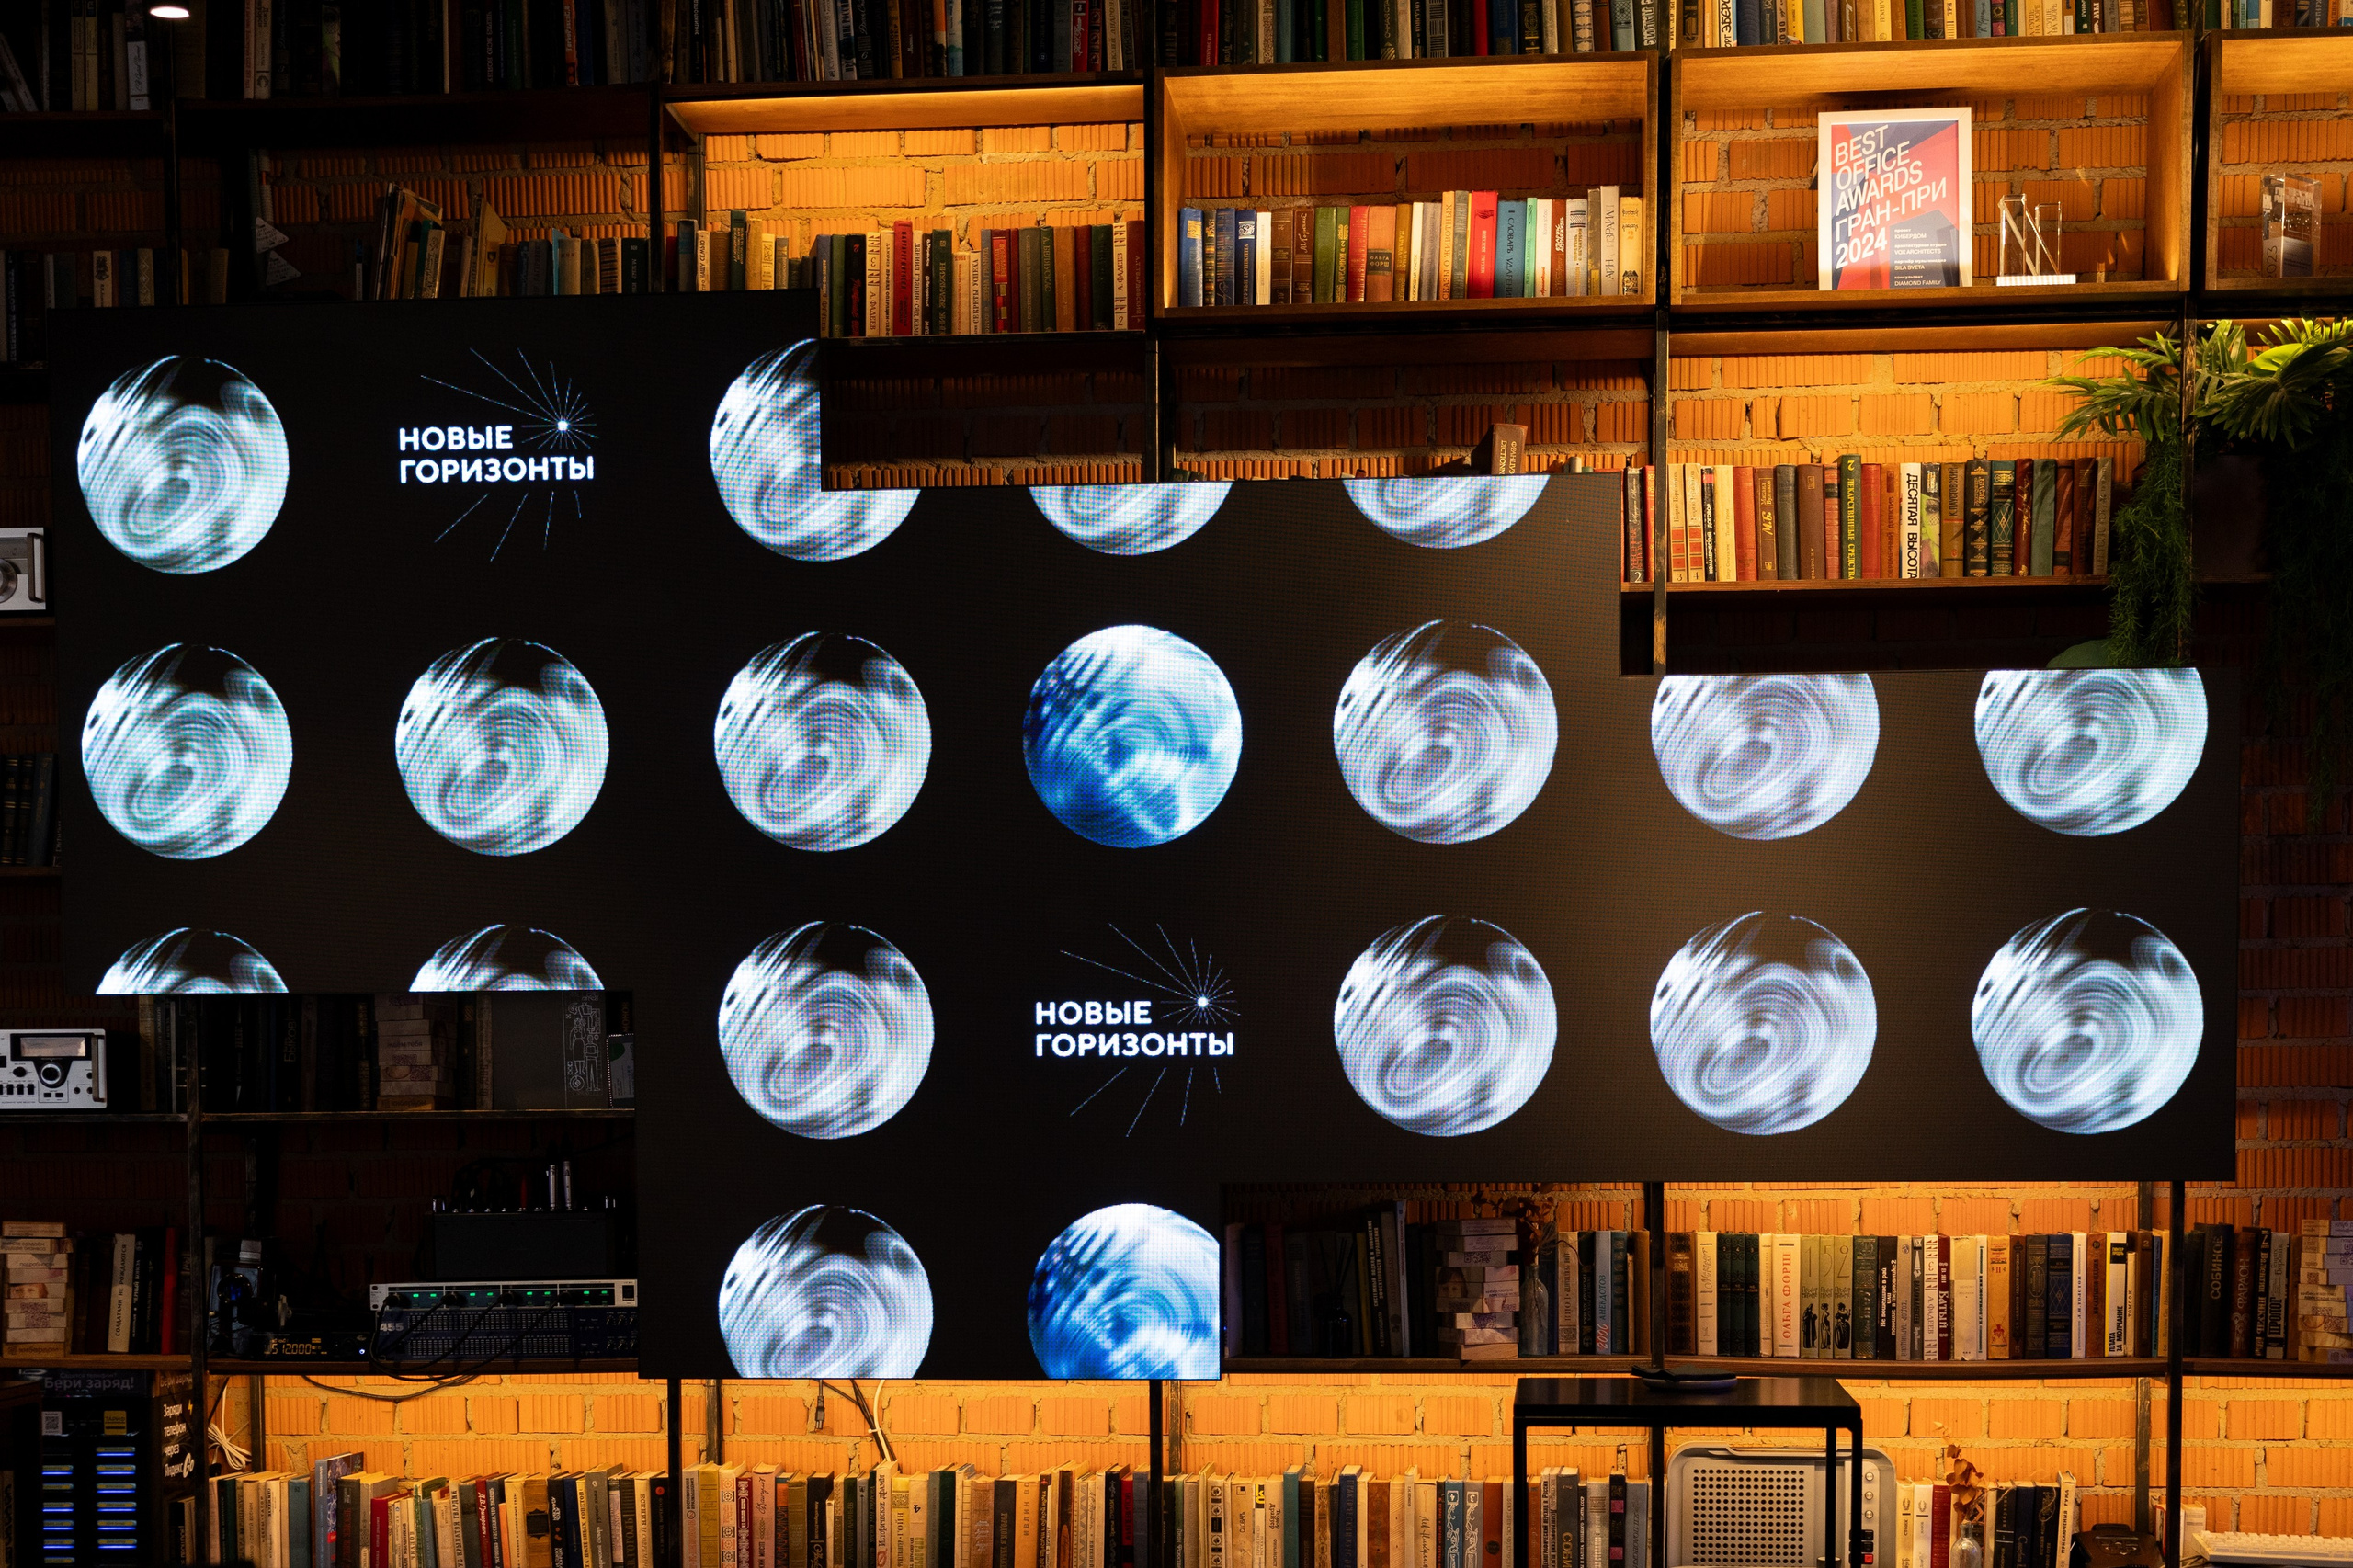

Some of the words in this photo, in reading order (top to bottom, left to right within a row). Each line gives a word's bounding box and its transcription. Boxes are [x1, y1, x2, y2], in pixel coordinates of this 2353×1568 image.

[1642, 7, 1656, 46] ЛАЦИС
[1835, 125, 1888, 166] BEST
[1836, 141, 1910, 189] OFFICE
[1836, 160, 1923, 216] AWARDS
[1836, 176, 1947, 242] ГРАН-ПРИ
[1444, 204, 1452, 257] ЖИВОТНЫХ
[1836, 227, 1888, 269] 2024
[911, 273, 921, 301] гранин
[913, 304, 921, 317] сад
[1119, 316, 1123, 326] 2
[400, 426, 513, 451] НОВЫЕ
[400, 456, 594, 483] ГОРИЗОНТЫ
[1847, 460, 1855, 471] 2
[1907, 473, 1917, 526] ДЕСЯТАЯ
[1949, 467, 1958, 516] К.ПАУСТОВСКИЙ
[1907, 532, 1917, 578] ВЫСОТА
[1634, 572, 1642, 583] 2
[1035, 1001, 1153, 1025] НОВЫЕ
[1036, 1032, 1233, 1056] ГОРИЗОНТЫ
[1367, 1221, 1375, 1249] ПОВЫШЕНИЕ
[1373, 1228, 1382, 1257] УПРАВЛЕНИЯ
[118, 1245, 127, 1286] РОЖДАЮТСЯ
[1781, 1253, 1792, 1297] ФОРШ
[1823, 1245, 1833, 1277] 5
[1836, 1245, 1849, 1278] 2
[2258, 1251, 2268, 1291] Валентин
[116, 1289, 123, 1298] НЕ
[1376, 1259, 1384, 1300] ЭФФЕКТИВНОСТИ
[2236, 1258, 2250, 1308] ФАРАОН
[114, 1300, 123, 1337] СОЛДАТАМИ
[1563, 1296, 1572, 1321] ГОЙЯ
[1782, 1301, 1792, 1339] ОЛЬГА
[1881, 1319, 1886, 1327] Не
[1939, 1290, 1949, 1328] БАТЫЙ
[2256, 1296, 2267, 1334] ПИКУЛЬ
[2268, 1297, 2283, 1335] ПРОЛОГ
[380, 1322, 404, 1332] 455
[1597, 1324, 1608, 1351] 2000
[1900, 1323, 1908, 1357] ПАРНИЦКИЙ
[44, 1377, 81, 1390] Бери
[82, 1378, 134, 1391] заряд!
[164, 1402, 182, 1418] Заряди
[165, 1423, 188, 1437] телефон
[164, 1443, 180, 1457] через
[164, 1461, 184, 1478] Яндекс
[183, 1452, 195, 1478] Go
[880, 1502, 888, 1547] Исторические
[914, 1505, 921, 1513] 4
[1346, 1480, 1355, 1537] ПРАКТИЧЕСКИЙ
[454, 1521, 463, 1555] КРЫЛАТОЙ
